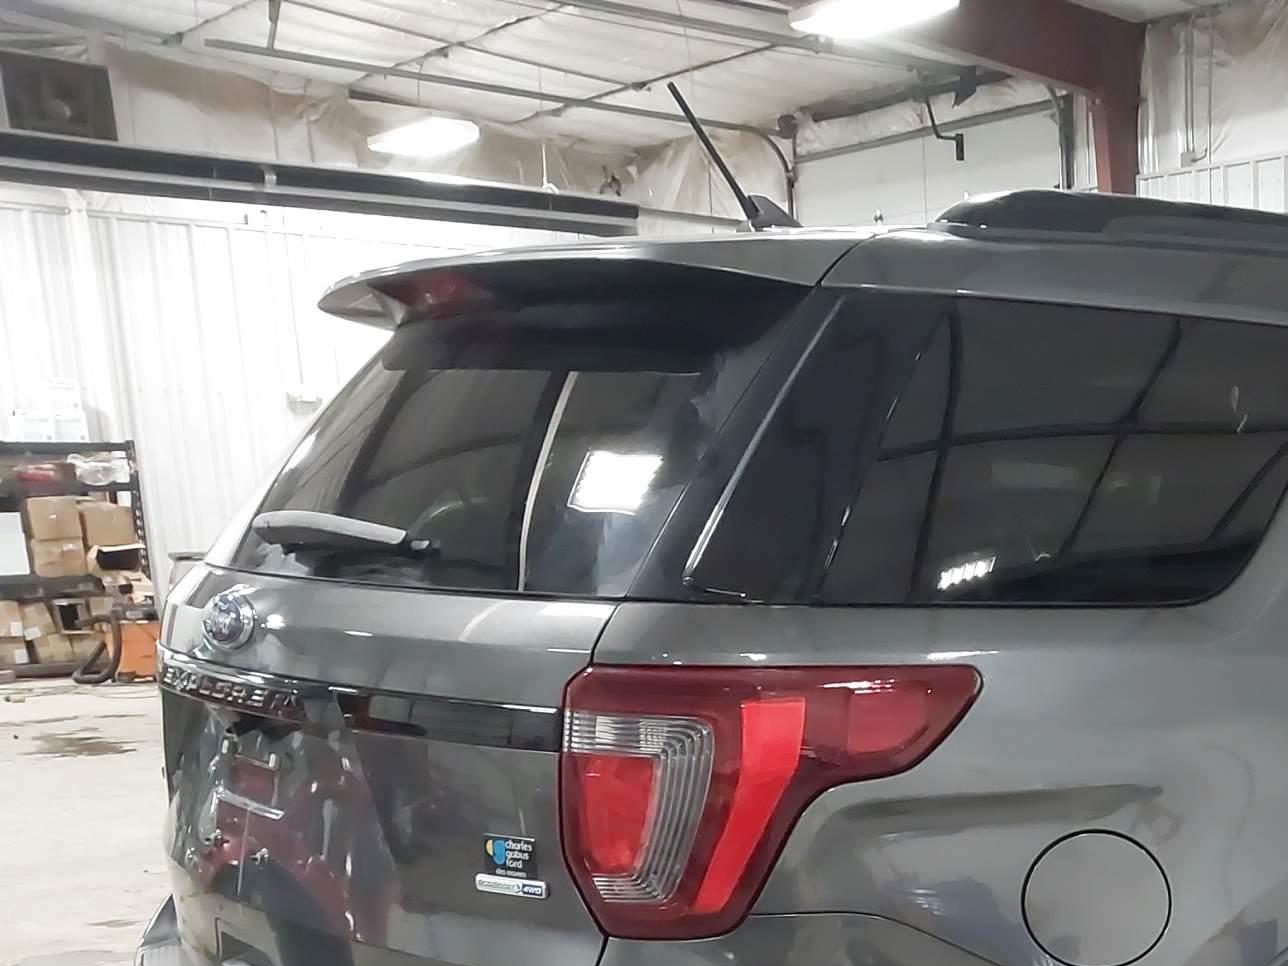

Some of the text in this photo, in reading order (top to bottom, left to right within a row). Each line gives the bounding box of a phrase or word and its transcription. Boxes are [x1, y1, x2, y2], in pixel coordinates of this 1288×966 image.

[163, 667, 298, 710] EXPLORER
[505, 839, 532, 851] charles
[506, 859, 523, 868] ford
